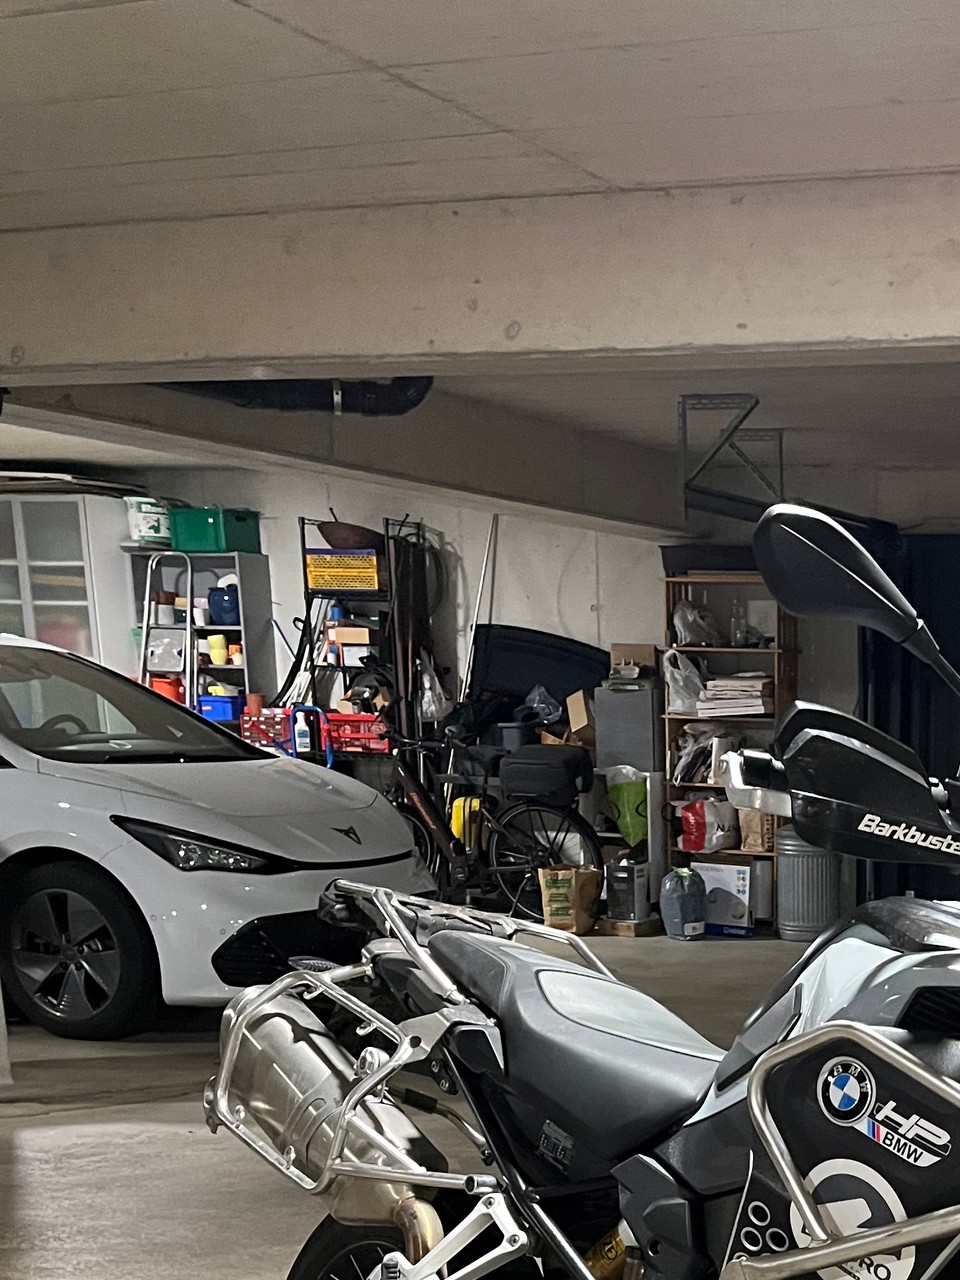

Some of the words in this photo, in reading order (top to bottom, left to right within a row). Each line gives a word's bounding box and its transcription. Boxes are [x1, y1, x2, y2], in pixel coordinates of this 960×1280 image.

[833, 1064, 870, 1093] BMW
[875, 1100, 951, 1146] HP
[882, 1130, 924, 1164] BMW
